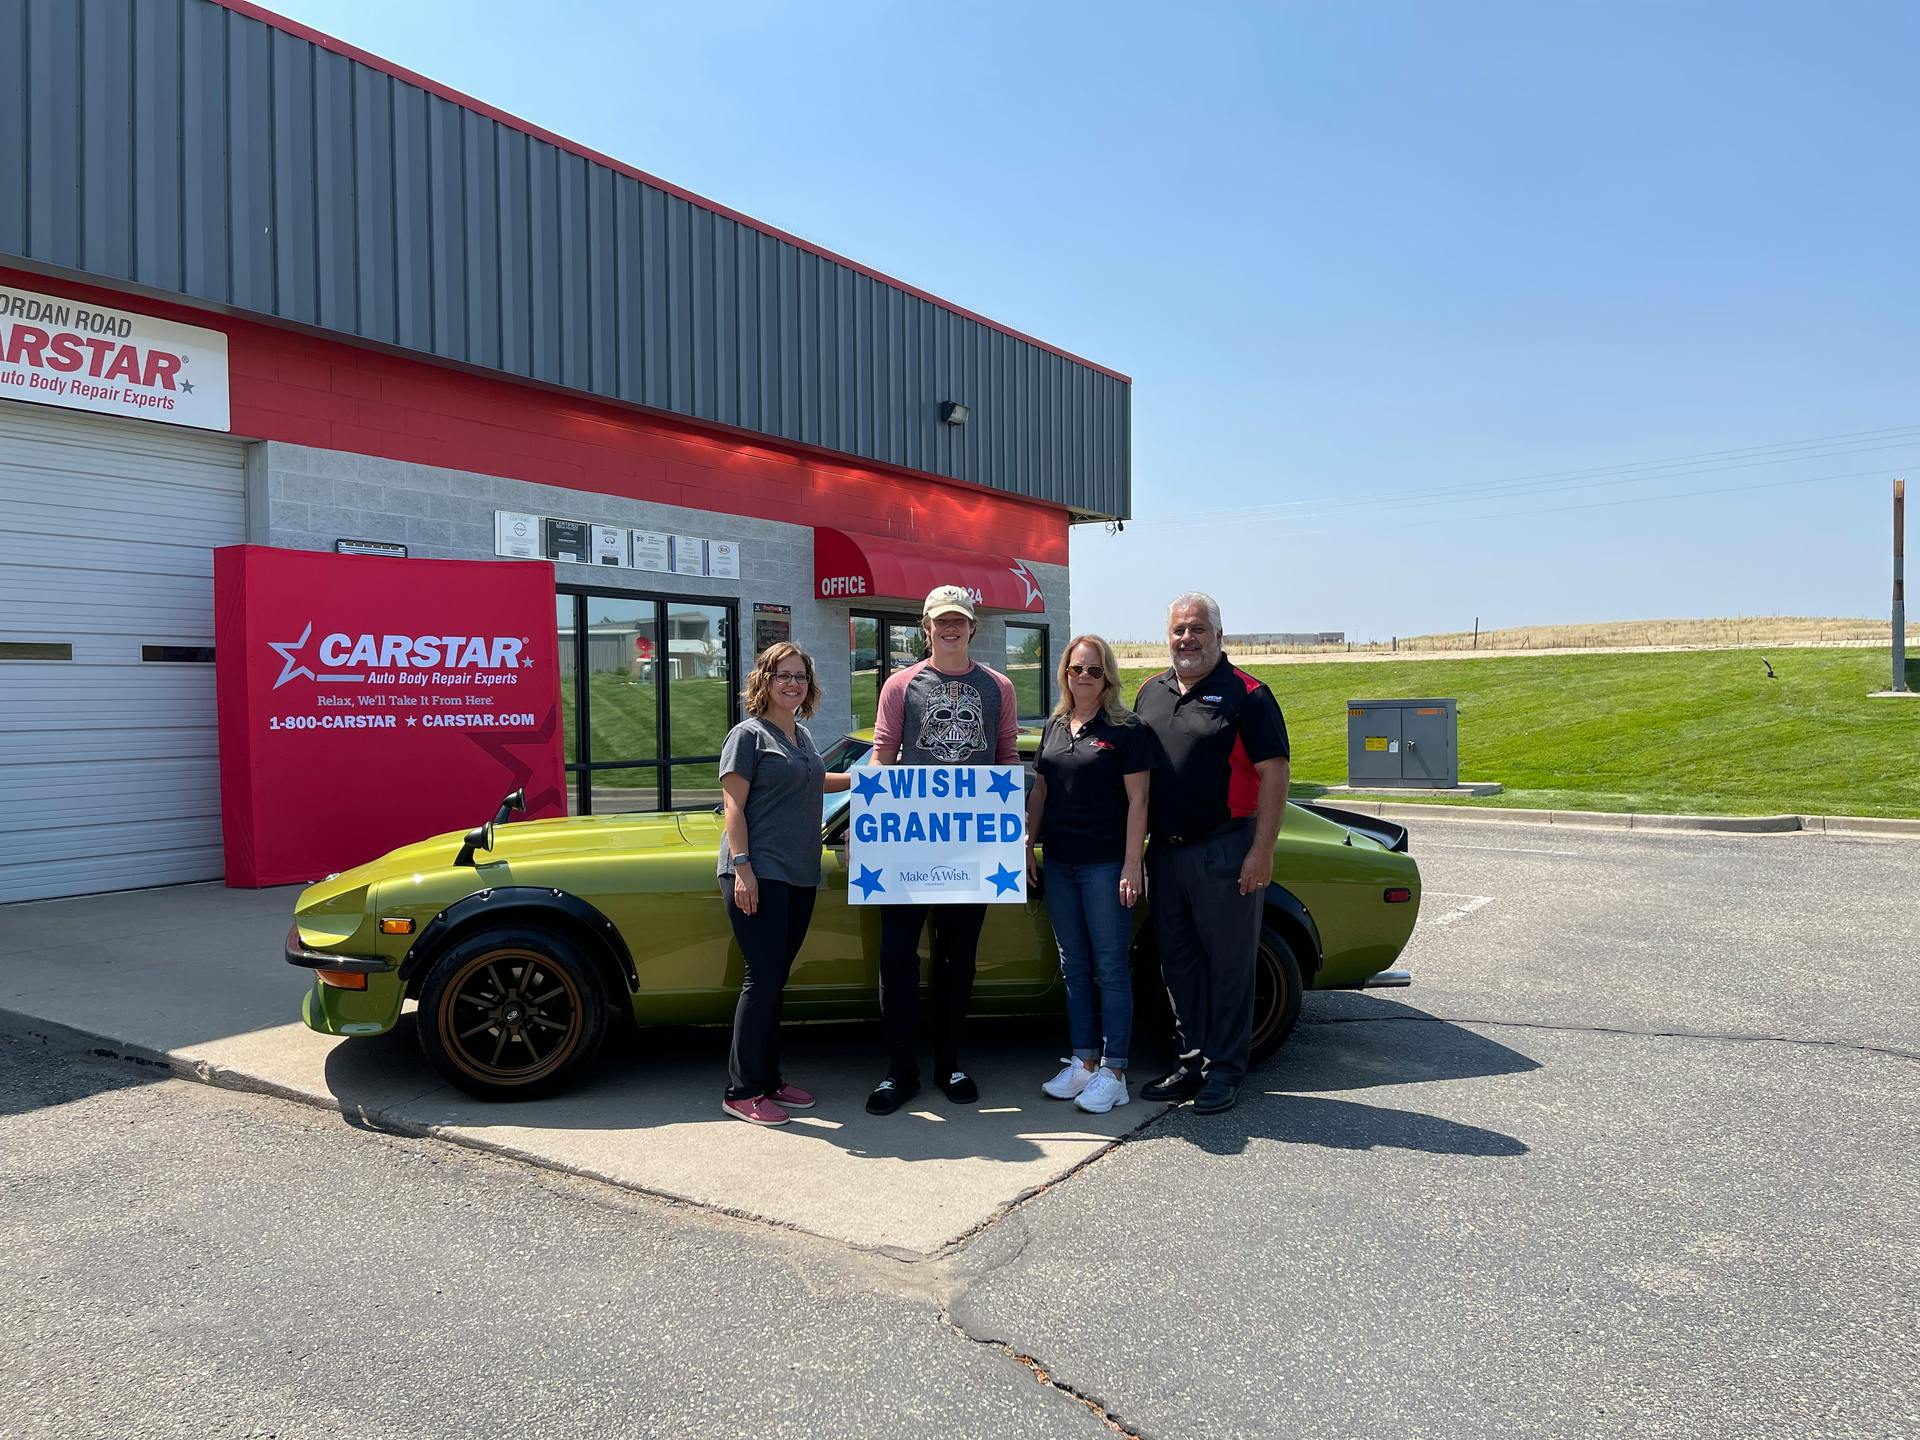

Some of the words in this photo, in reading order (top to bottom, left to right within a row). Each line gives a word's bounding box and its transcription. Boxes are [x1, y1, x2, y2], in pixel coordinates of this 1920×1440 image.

[75, 309, 132, 338] ROAD
[0, 323, 182, 391] RSTAR
[30, 372, 67, 395] Body
[71, 379, 120, 401] Repair
[123, 388, 175, 410] Experts
[821, 575, 866, 596] OFFICE
[961, 586, 983, 605] 24
[319, 633, 523, 668] CARSTAR
[368, 671, 396, 684] Auto
[398, 672, 429, 687] Body
[432, 672, 471, 687] Repair
[474, 672, 518, 687] Experts
[317, 695, 355, 707] Relax,
[357, 694, 386, 706] We'll
[388, 694, 417, 706] Take
[420, 695, 430, 706] It
[432, 695, 463, 706] From
[269, 714, 397, 730] 1-800-CARSTAR
[422, 713, 535, 728] CARSTAR.COM
[888, 767, 976, 799] WISH
[855, 811, 1022, 843] GRANTED
[899, 871, 929, 882] Make
